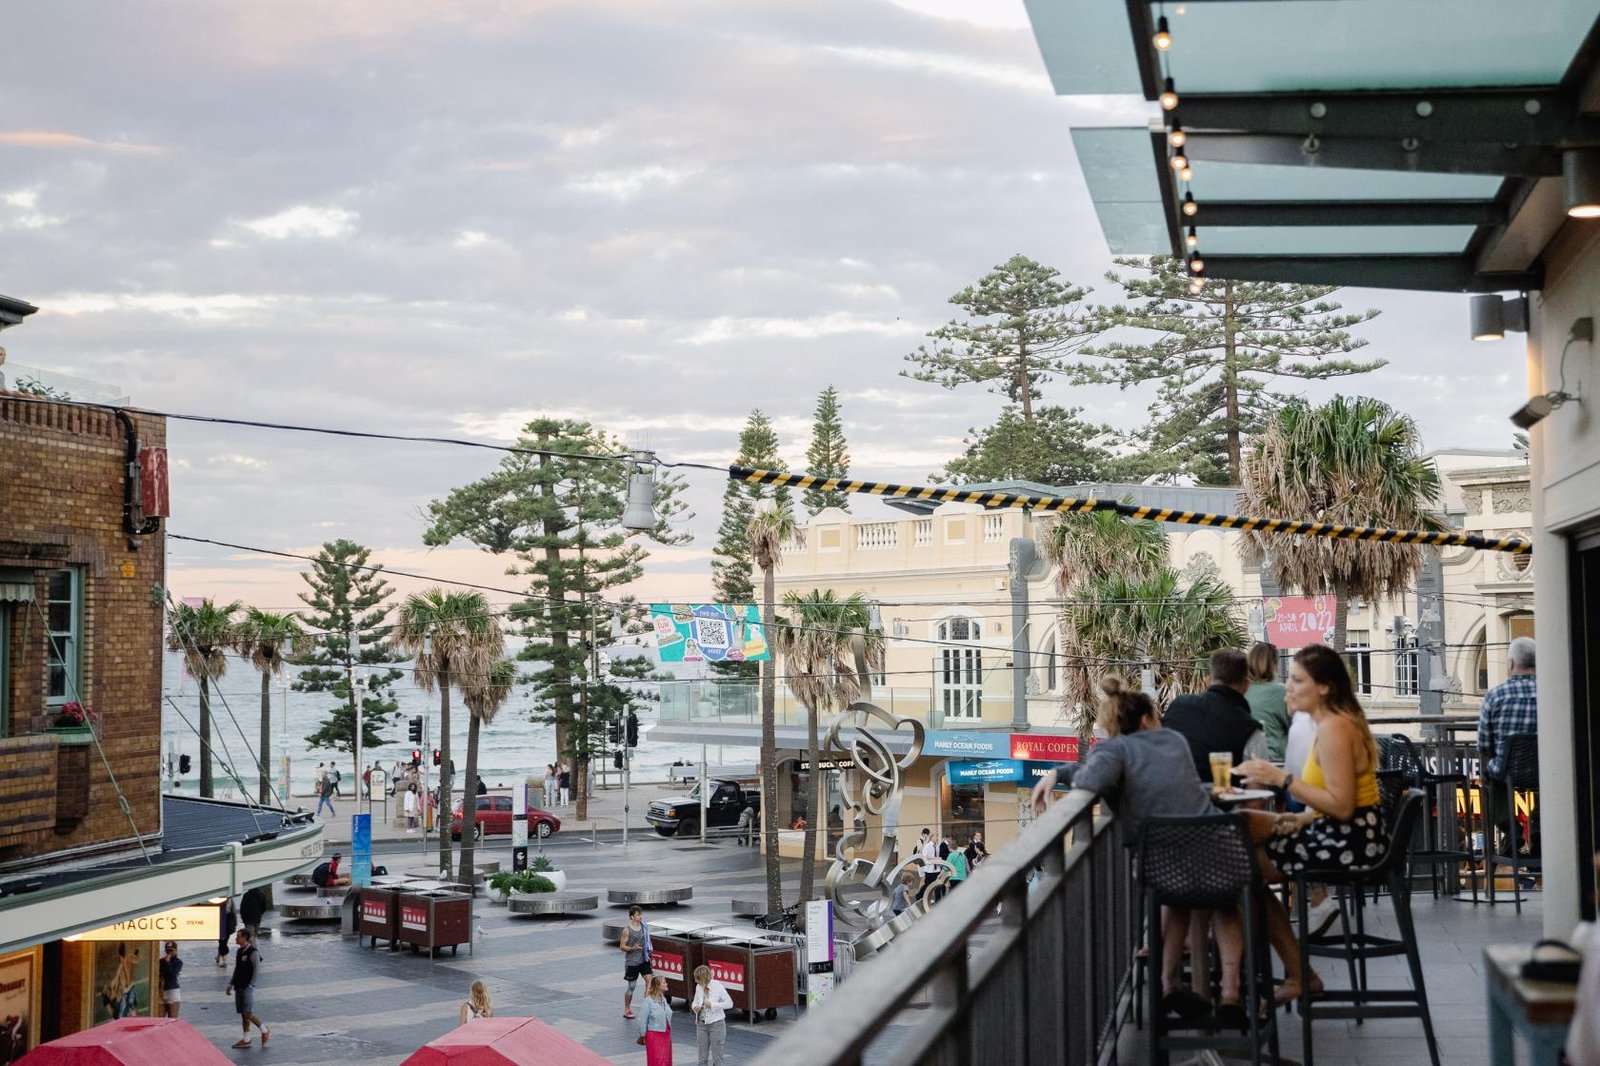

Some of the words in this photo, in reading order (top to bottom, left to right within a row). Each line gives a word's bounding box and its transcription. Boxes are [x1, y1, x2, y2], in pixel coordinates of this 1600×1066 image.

[934, 740, 953, 749] MANLY
[953, 742, 973, 750] OCEAN
[973, 743, 993, 751] FOODS
[1016, 741, 1045, 752] ROYAL
[1047, 742, 1079, 753] COPEN
[113, 917, 177, 930] MAGIC'S
